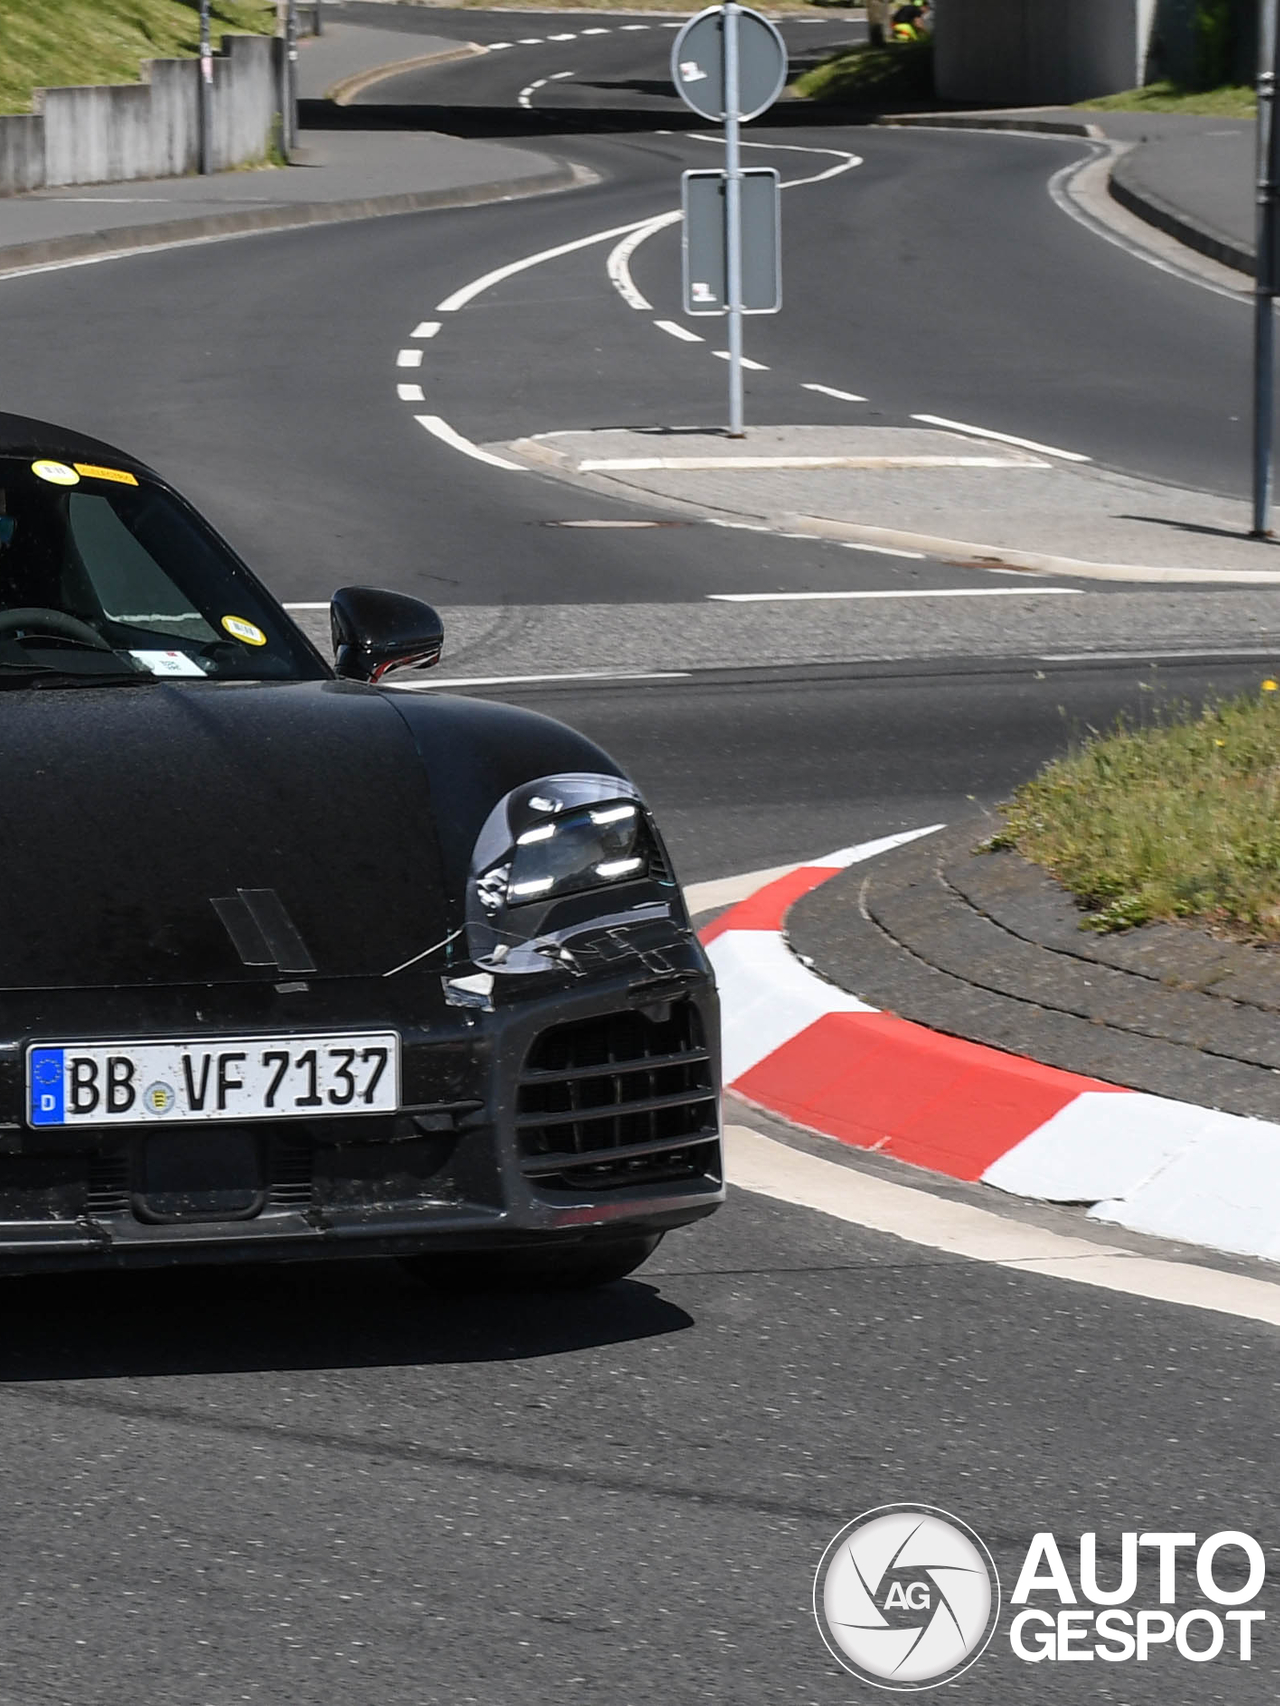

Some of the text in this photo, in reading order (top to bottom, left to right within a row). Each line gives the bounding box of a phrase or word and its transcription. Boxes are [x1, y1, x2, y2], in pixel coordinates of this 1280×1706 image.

[70, 1047, 388, 1114] BB VF 7137
[40, 1095, 55, 1111] D
